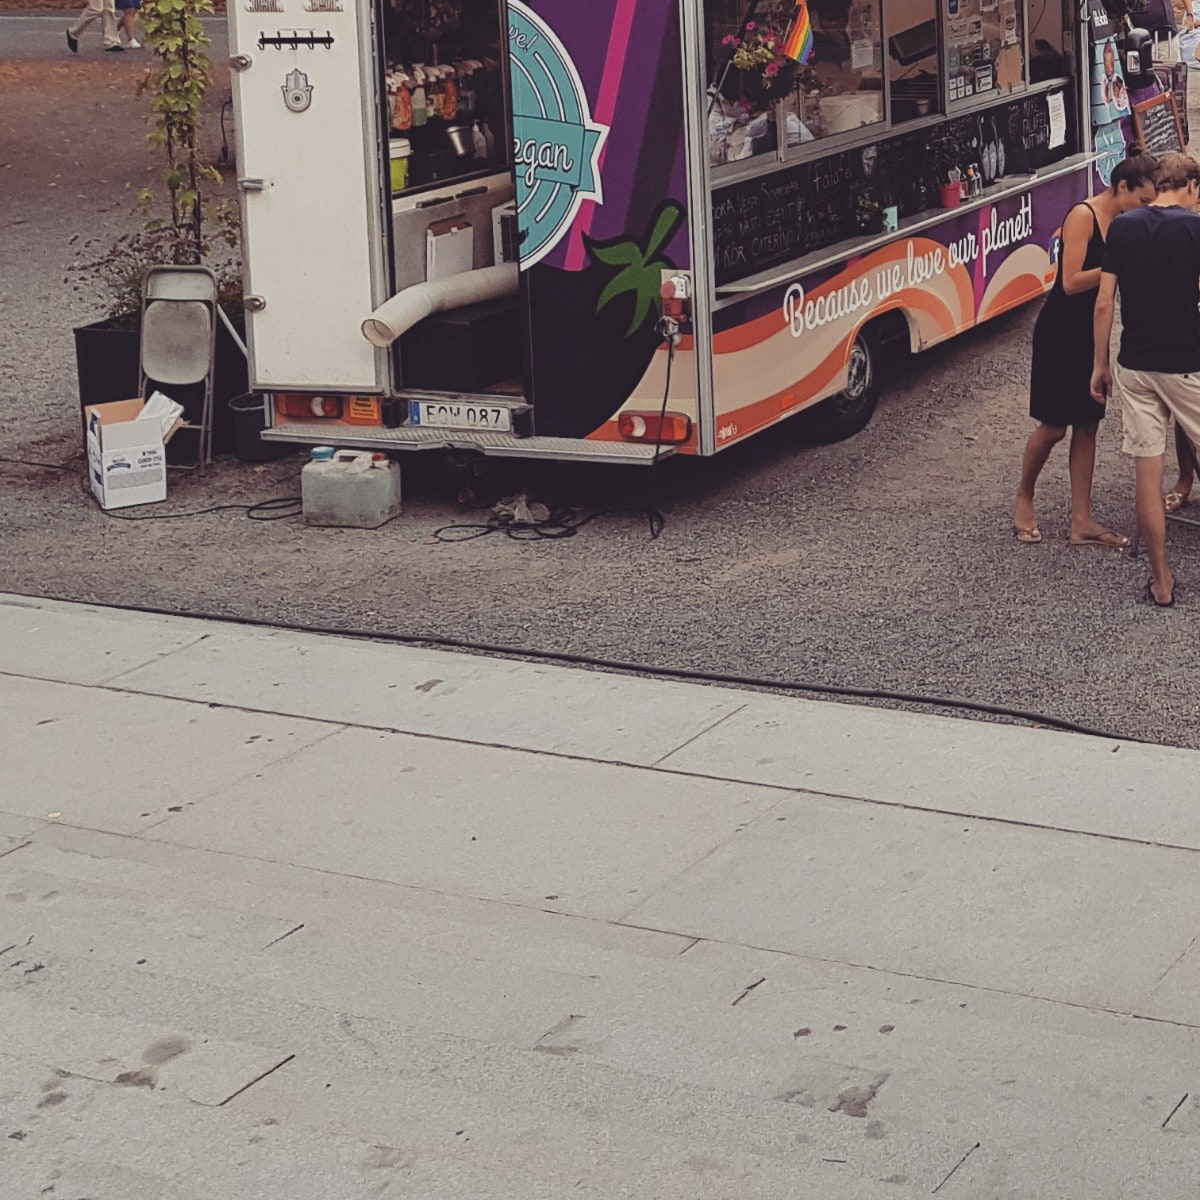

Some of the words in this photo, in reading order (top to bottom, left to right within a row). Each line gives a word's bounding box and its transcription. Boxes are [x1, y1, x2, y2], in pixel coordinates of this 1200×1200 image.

[513, 139, 573, 184] egan
[784, 282, 873, 338] Because
[876, 267, 906, 300] we
[907, 242, 945, 288] love
[949, 234, 980, 269] our
[981, 193, 1033, 278] planet!
